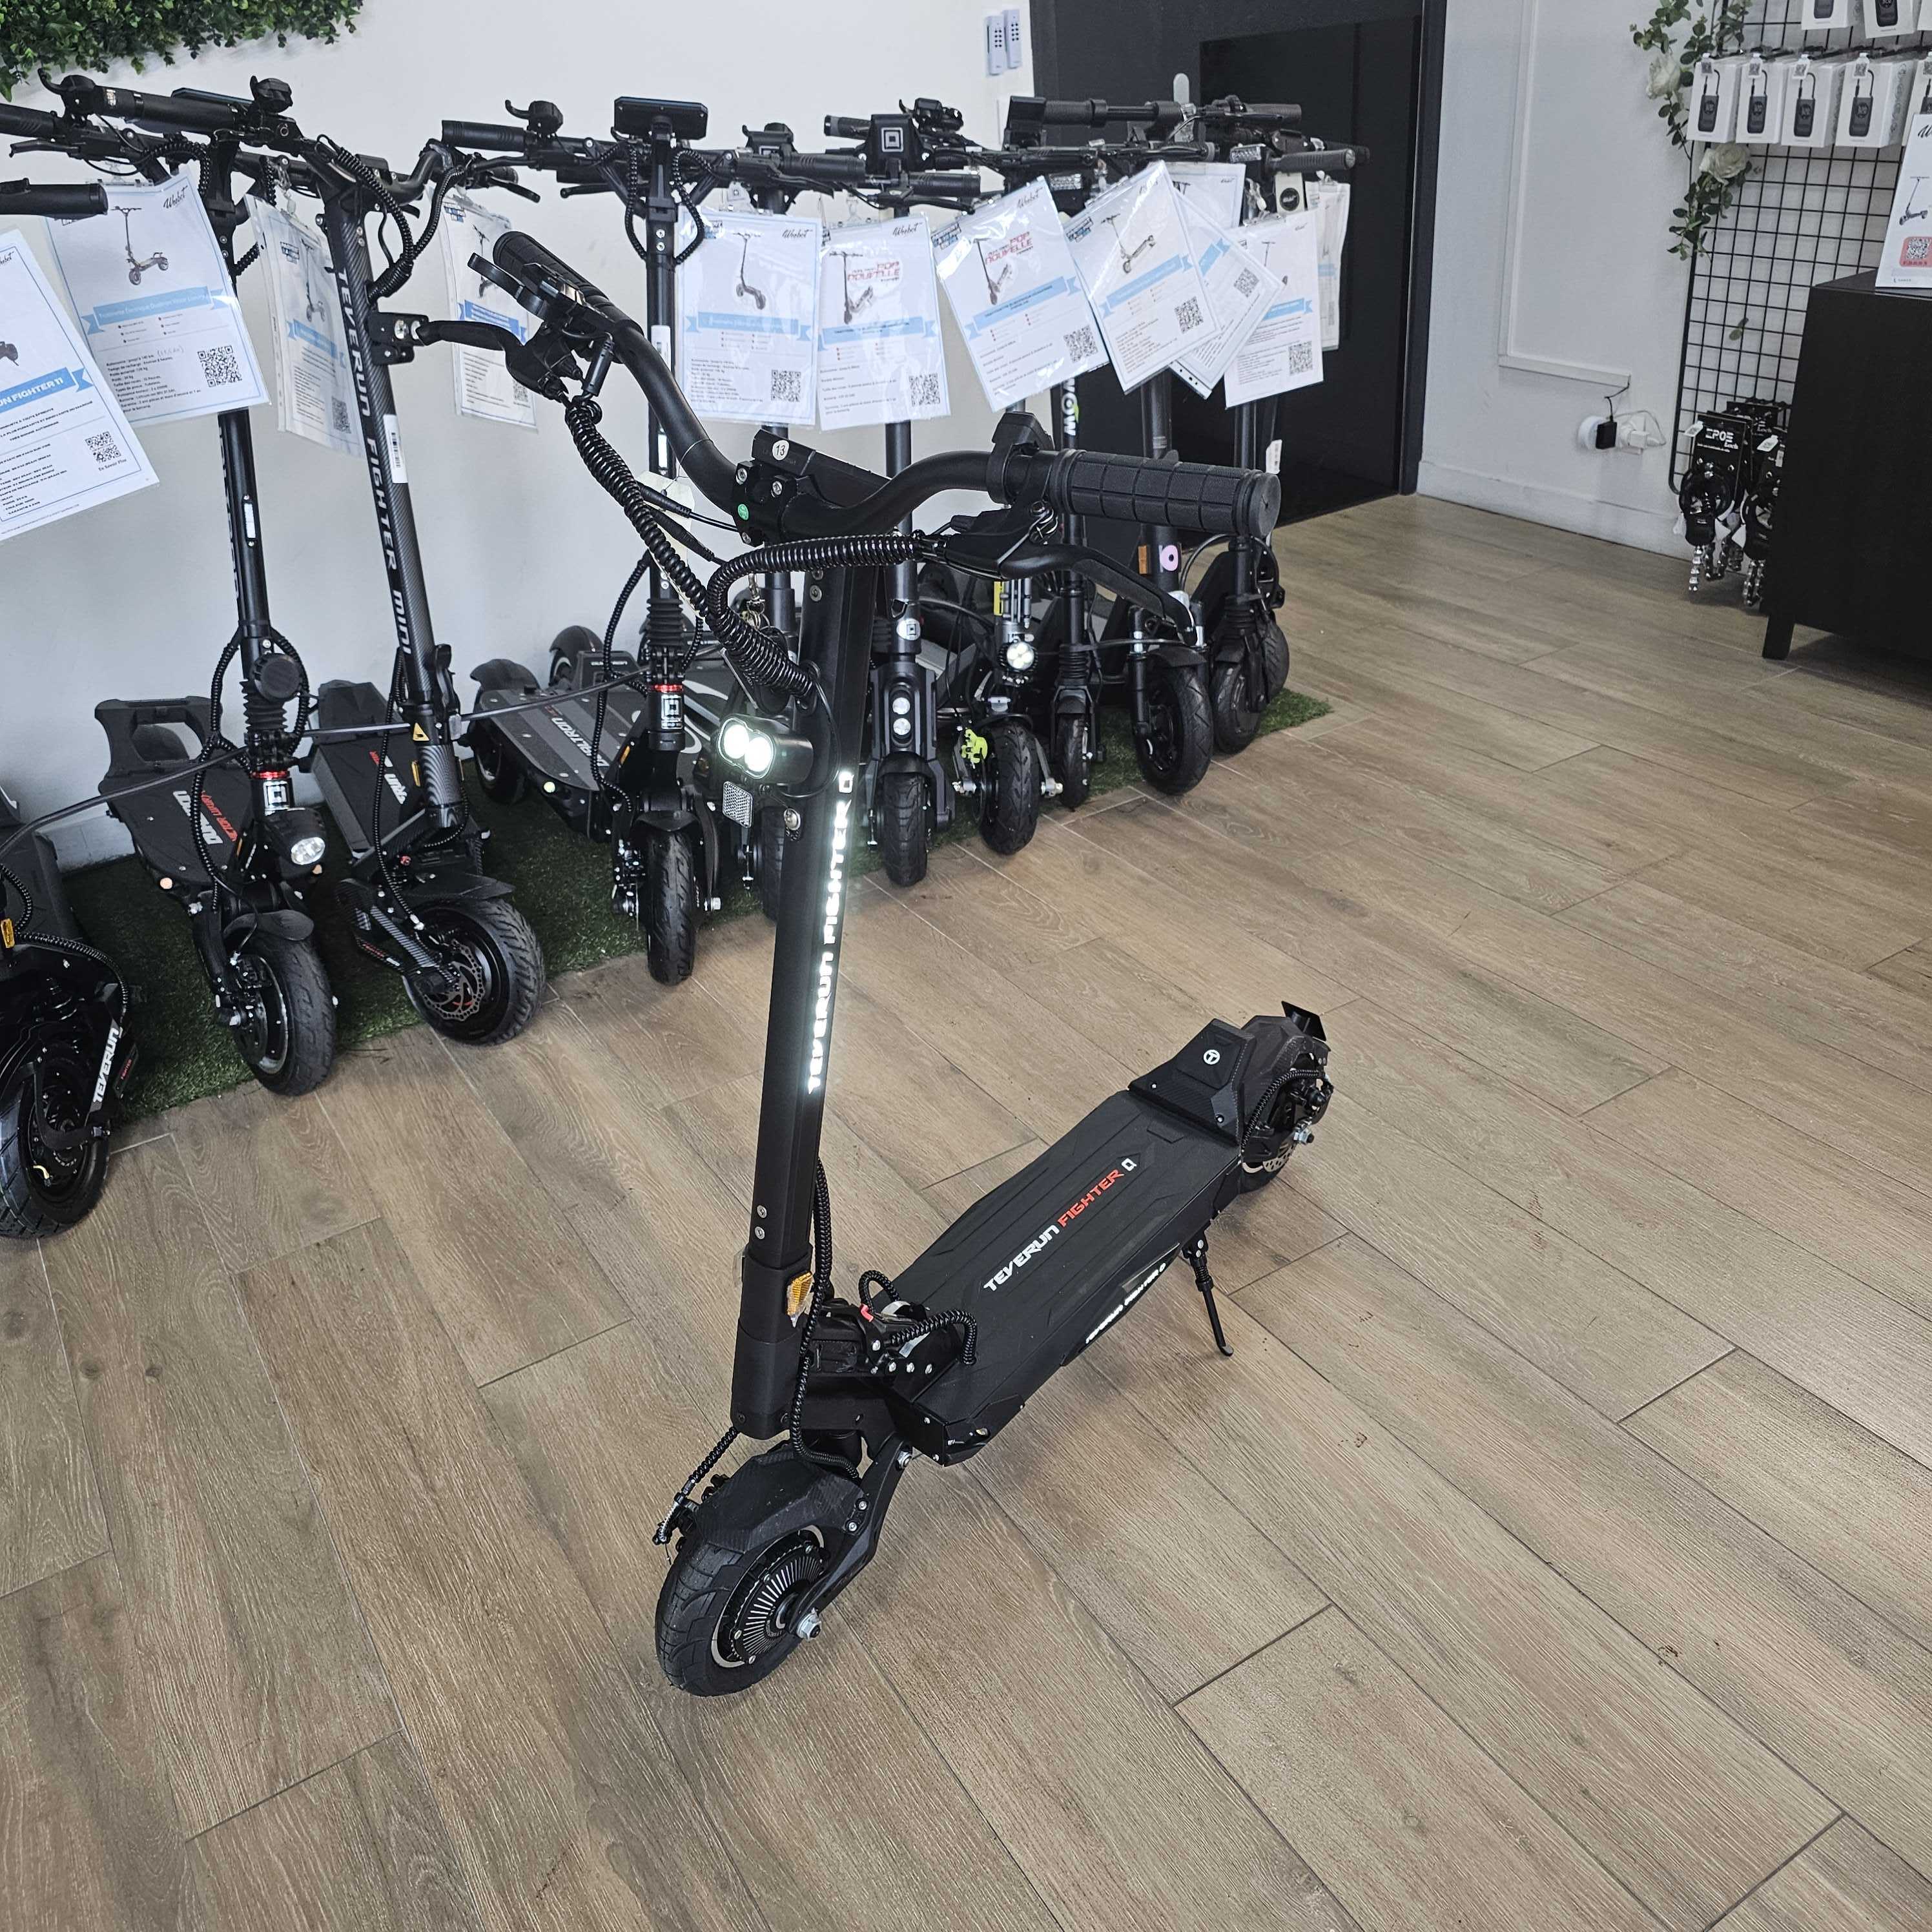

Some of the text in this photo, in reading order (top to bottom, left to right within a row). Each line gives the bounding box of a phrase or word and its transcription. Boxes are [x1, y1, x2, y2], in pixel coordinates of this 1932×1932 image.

[12, 380, 56, 402] FIGHTER
[338, 268, 411, 654] TEVERUN FIGHTER MINI
[776, 444, 786, 457] 13
[808, 952, 834, 1096] TEVERUN
[823, 799, 853, 945] FIGHTER
[92, 1027, 119, 1103] TEVERUN
[983, 1224, 1060, 1292] TEVERUN
[1057, 1169, 1125, 1228] FIGHTER
